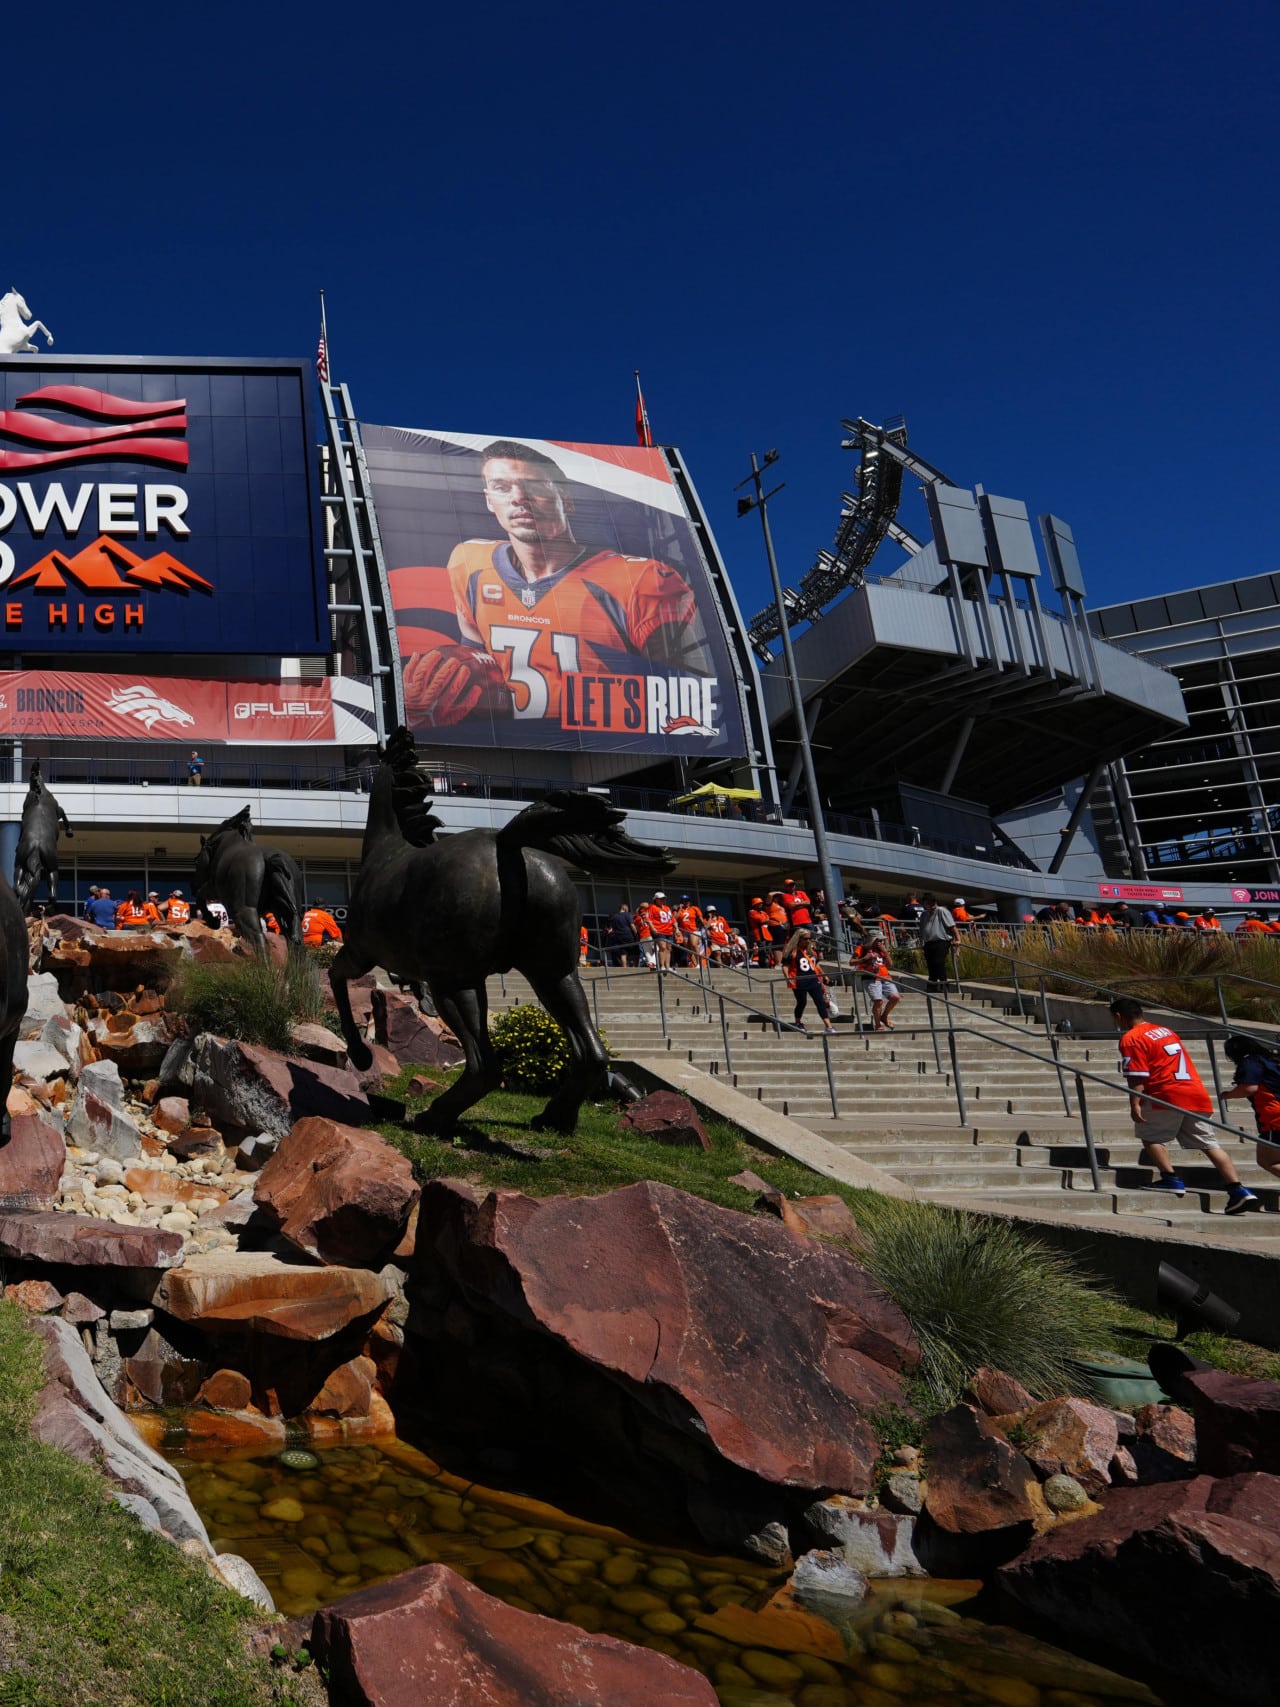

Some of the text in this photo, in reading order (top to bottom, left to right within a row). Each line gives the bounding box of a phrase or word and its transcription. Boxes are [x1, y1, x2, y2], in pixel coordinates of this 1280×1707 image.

[482, 583, 503, 599] C
[48, 603, 145, 625] HIGH
[507, 614, 551, 625] BRONCOS
[489, 624, 581, 719] 31
[16, 687, 85, 714] BRONCOS
[566, 675, 720, 736] LET'S RIDE
[11, 717, 43, 727] 2022
[1254, 890, 1279, 900] JOIN
[1162, 1042, 1192, 1081] 7
